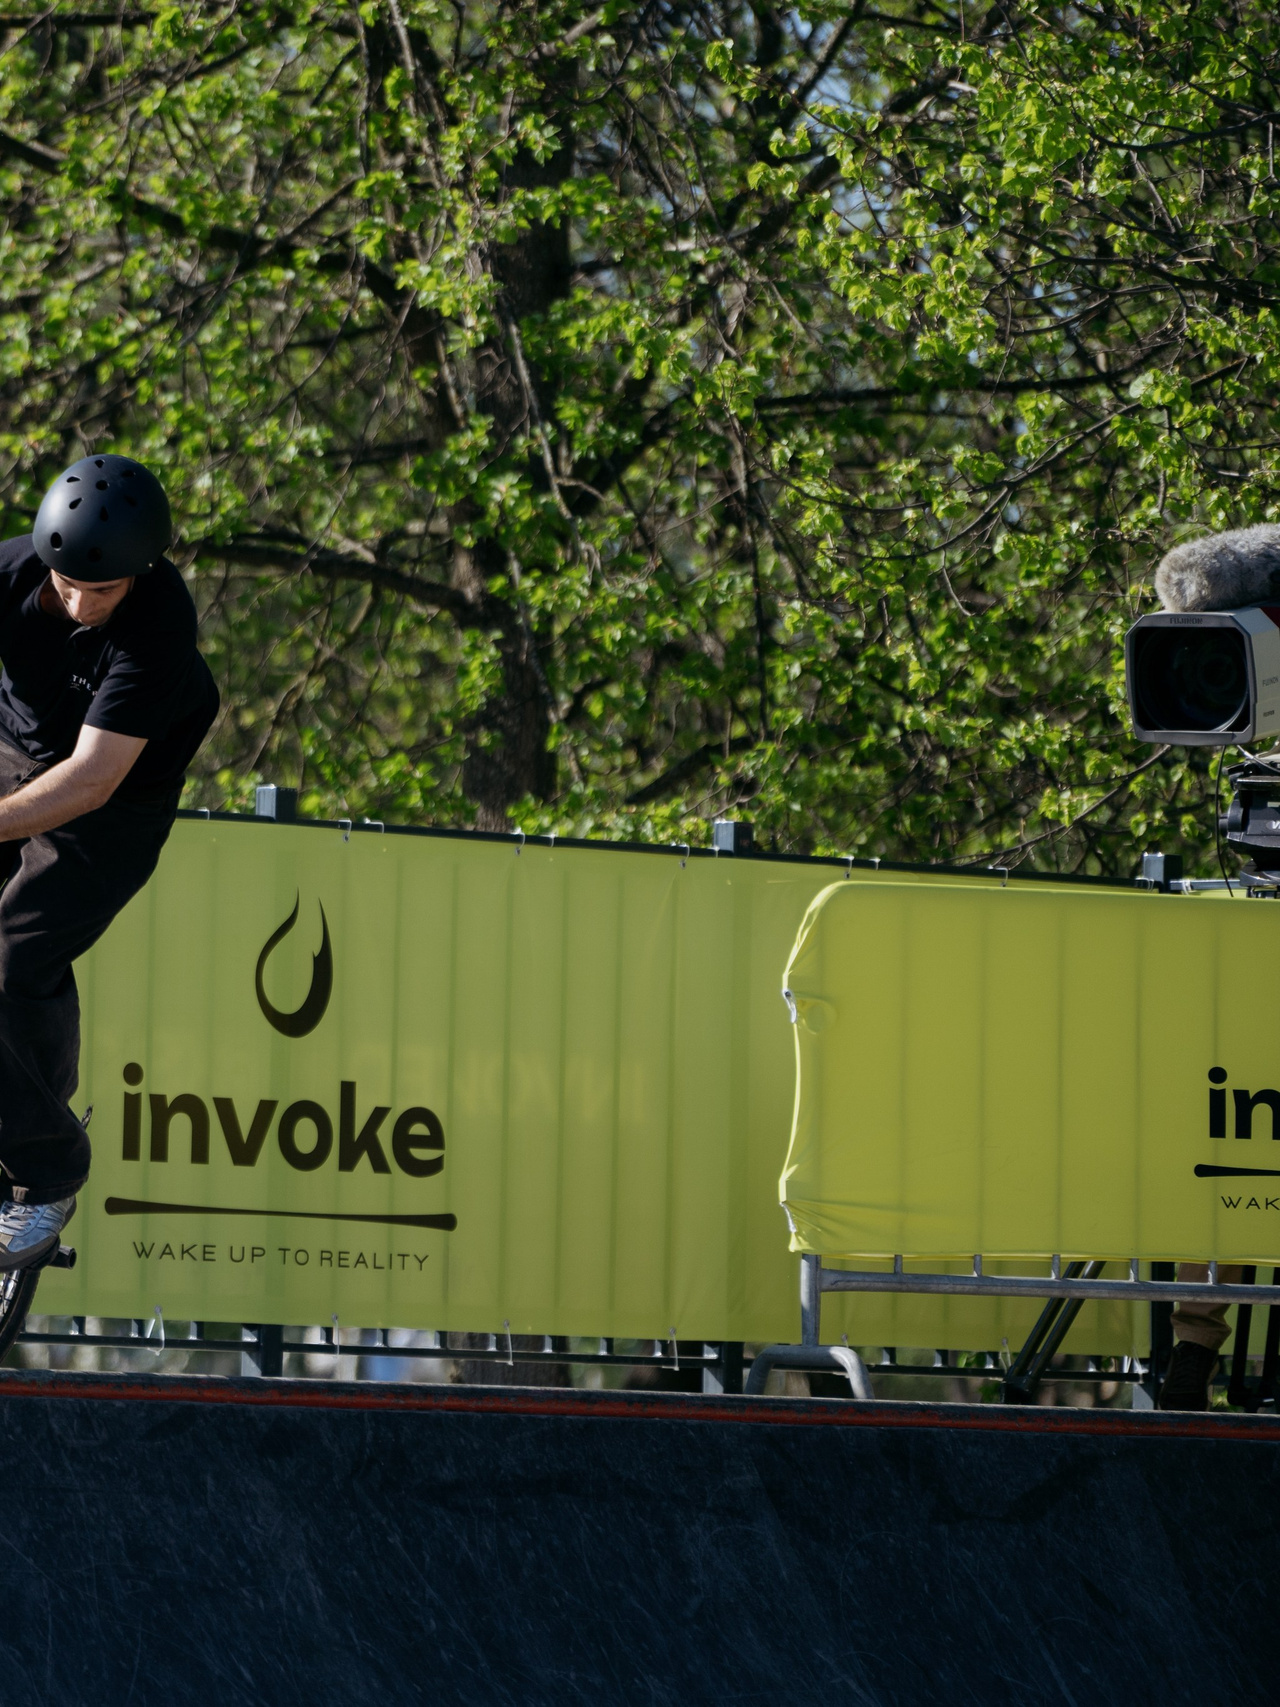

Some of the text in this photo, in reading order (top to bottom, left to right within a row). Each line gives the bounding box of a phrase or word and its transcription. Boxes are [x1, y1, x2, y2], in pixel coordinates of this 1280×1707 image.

[1169, 617, 1203, 625] FUJINON
[122, 1062, 445, 1178] invoke
[133, 1241, 429, 1271] WAKE UP TO REALITY
